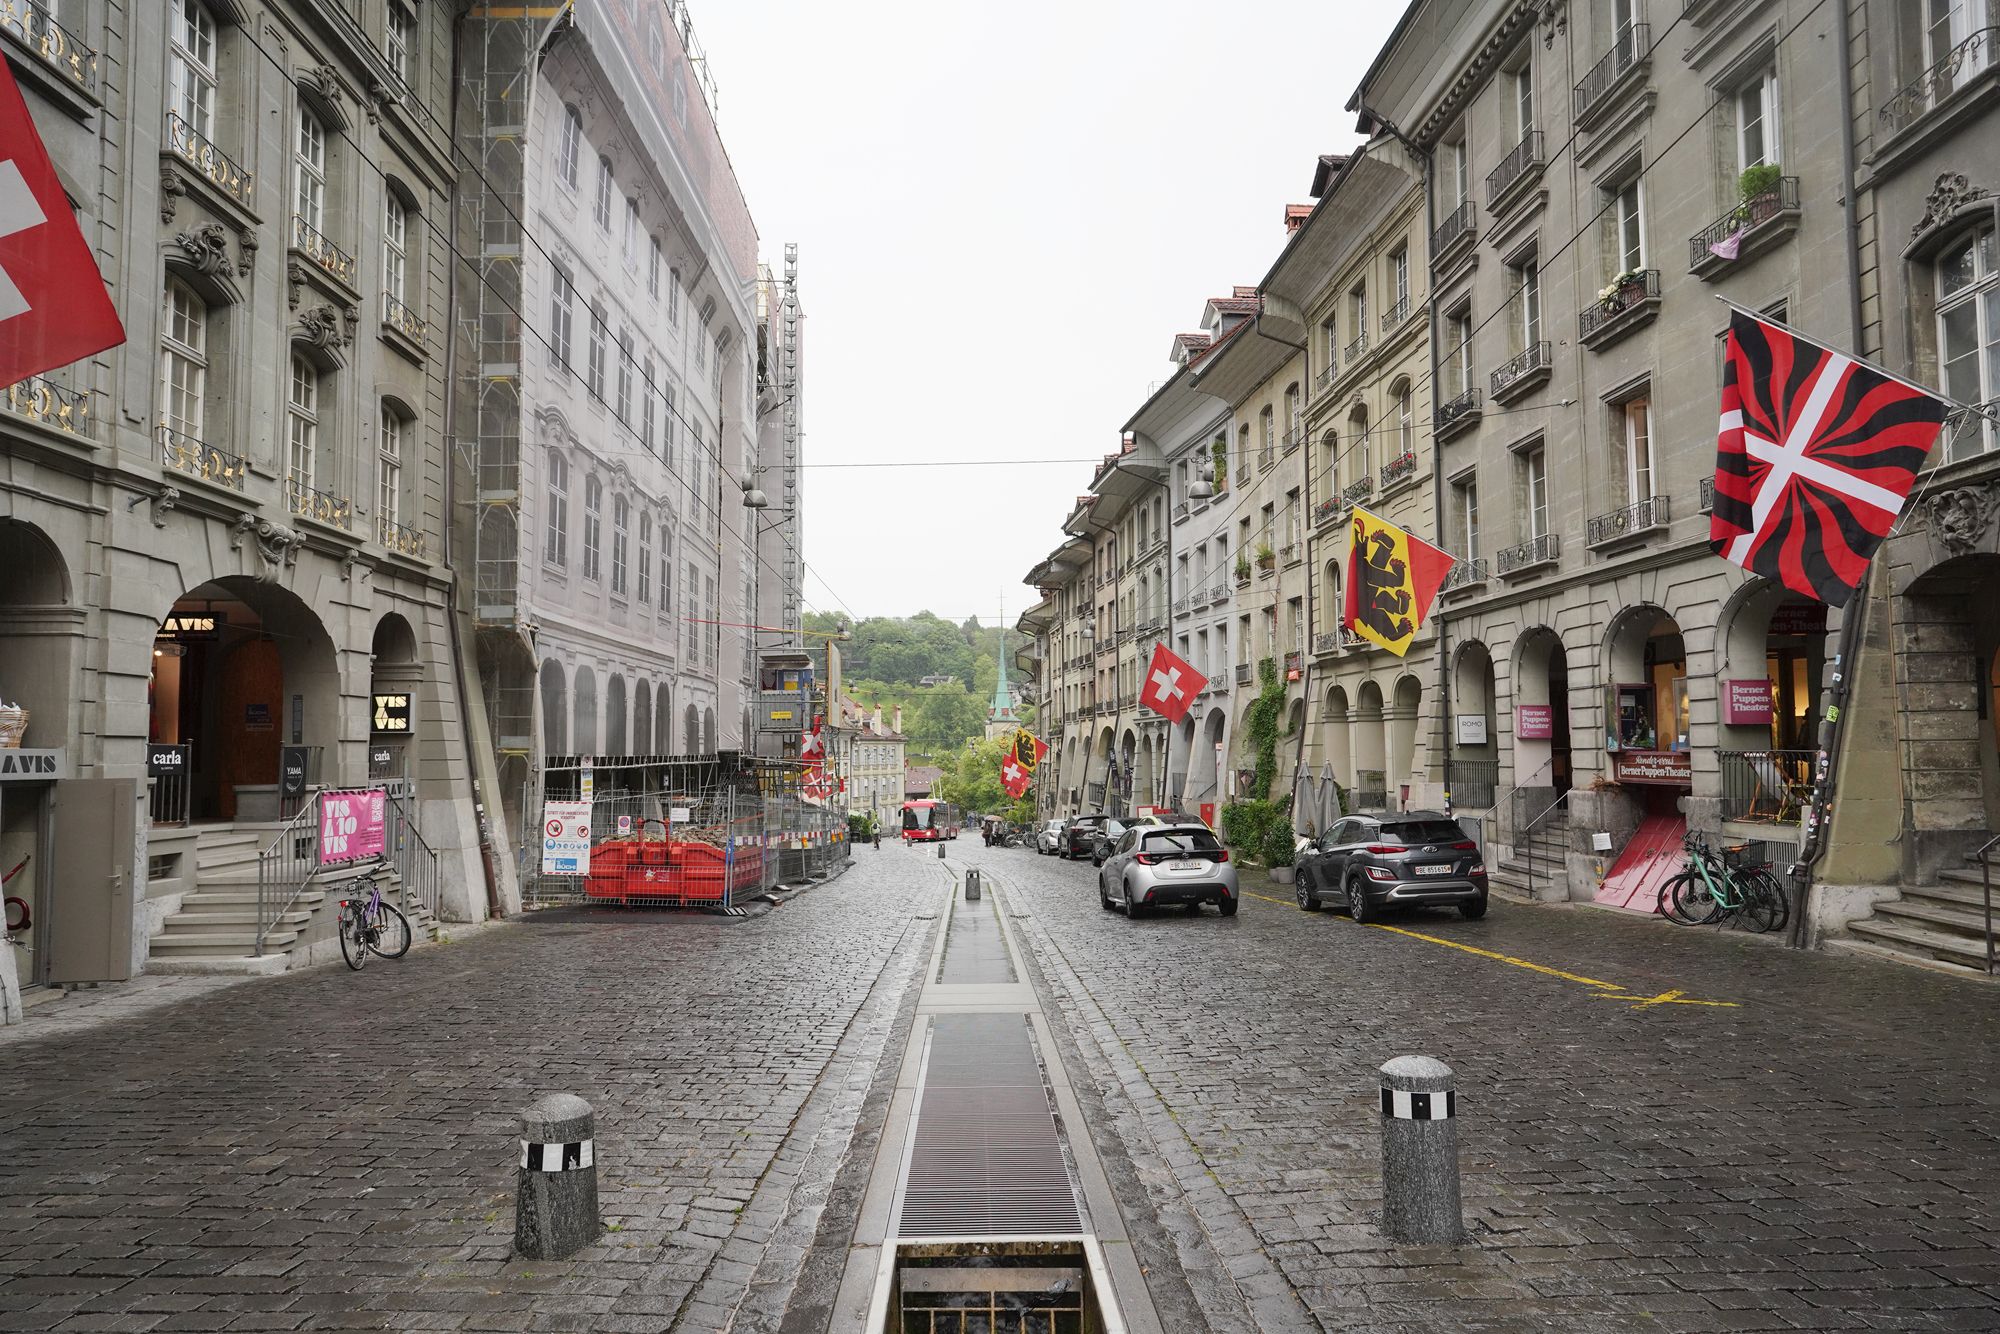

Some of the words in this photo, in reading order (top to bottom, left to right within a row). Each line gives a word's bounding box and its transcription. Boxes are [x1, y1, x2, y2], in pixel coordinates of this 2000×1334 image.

[1732, 685, 1765, 694] Berner
[374, 696, 407, 708] VIS
[1732, 694, 1770, 703] Puppen-
[1733, 703, 1769, 712] Theater
[374, 718, 407, 730] VIS
[152, 750, 182, 765] carla
[374, 750, 390, 761] carla
[287, 767, 302, 775] YAMA
[1620, 765, 1641, 776] Berner
[1641, 765, 1692, 778] Puppen-Theater
[324, 799, 350, 819] VIS
[335, 816, 358, 835] 10
[323, 834, 348, 855] VIS
